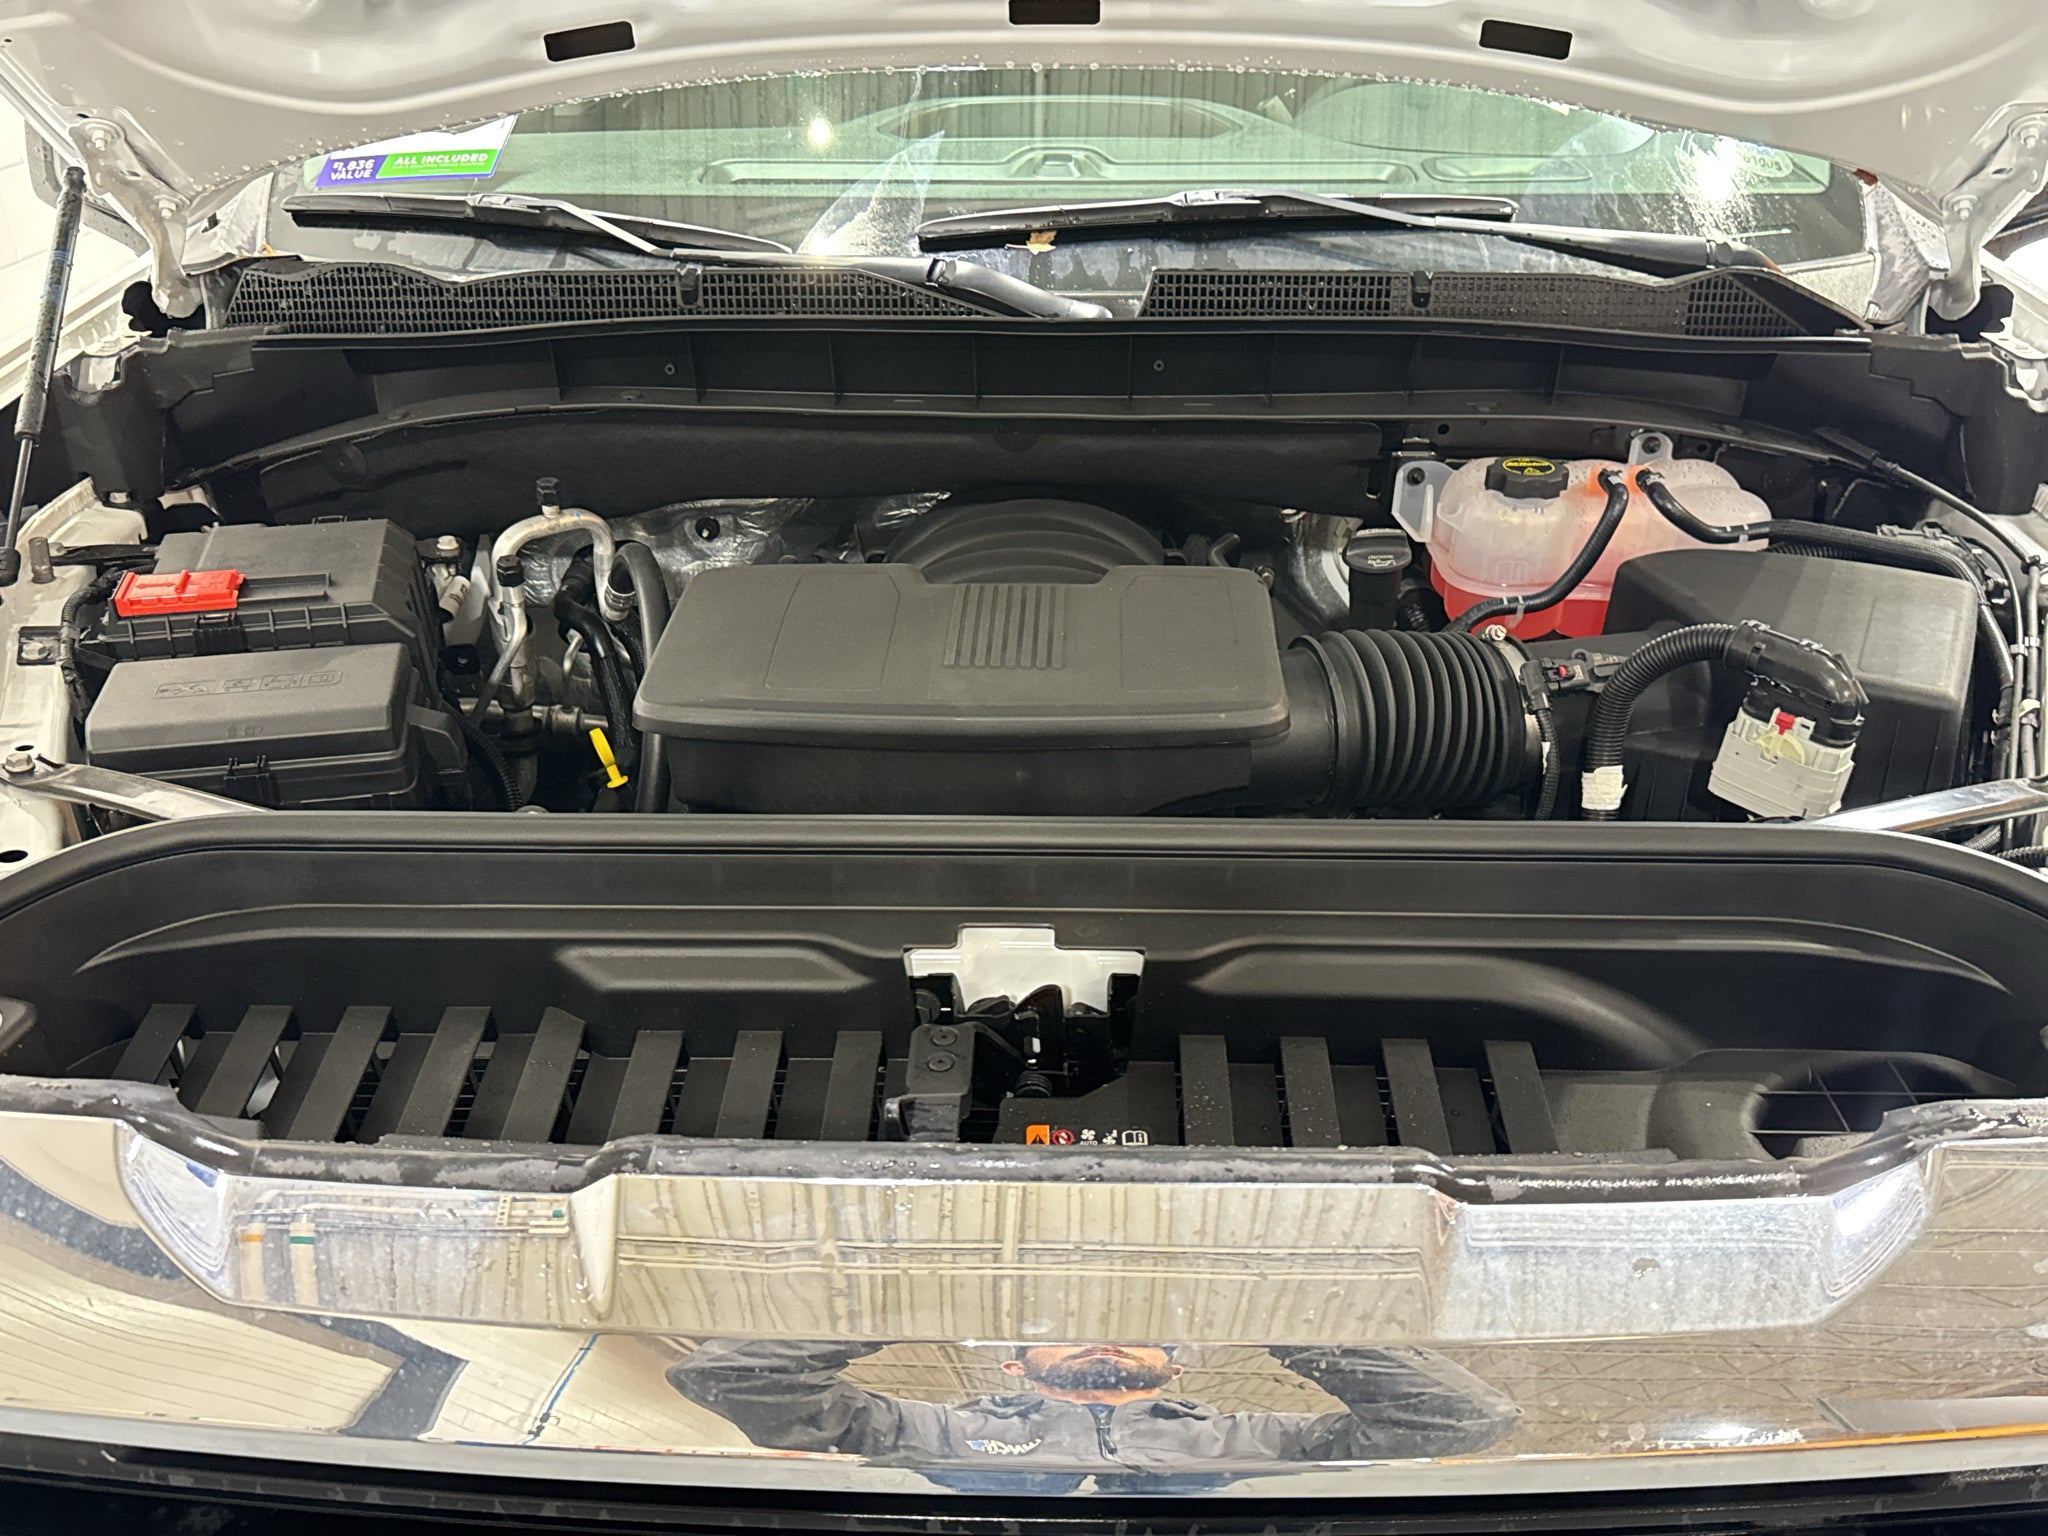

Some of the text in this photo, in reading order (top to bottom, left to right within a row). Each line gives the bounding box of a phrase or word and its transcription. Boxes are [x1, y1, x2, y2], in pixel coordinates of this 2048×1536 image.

[394, 153, 488, 165] ALL INCLUDED
[331, 169, 373, 181] VALUE
